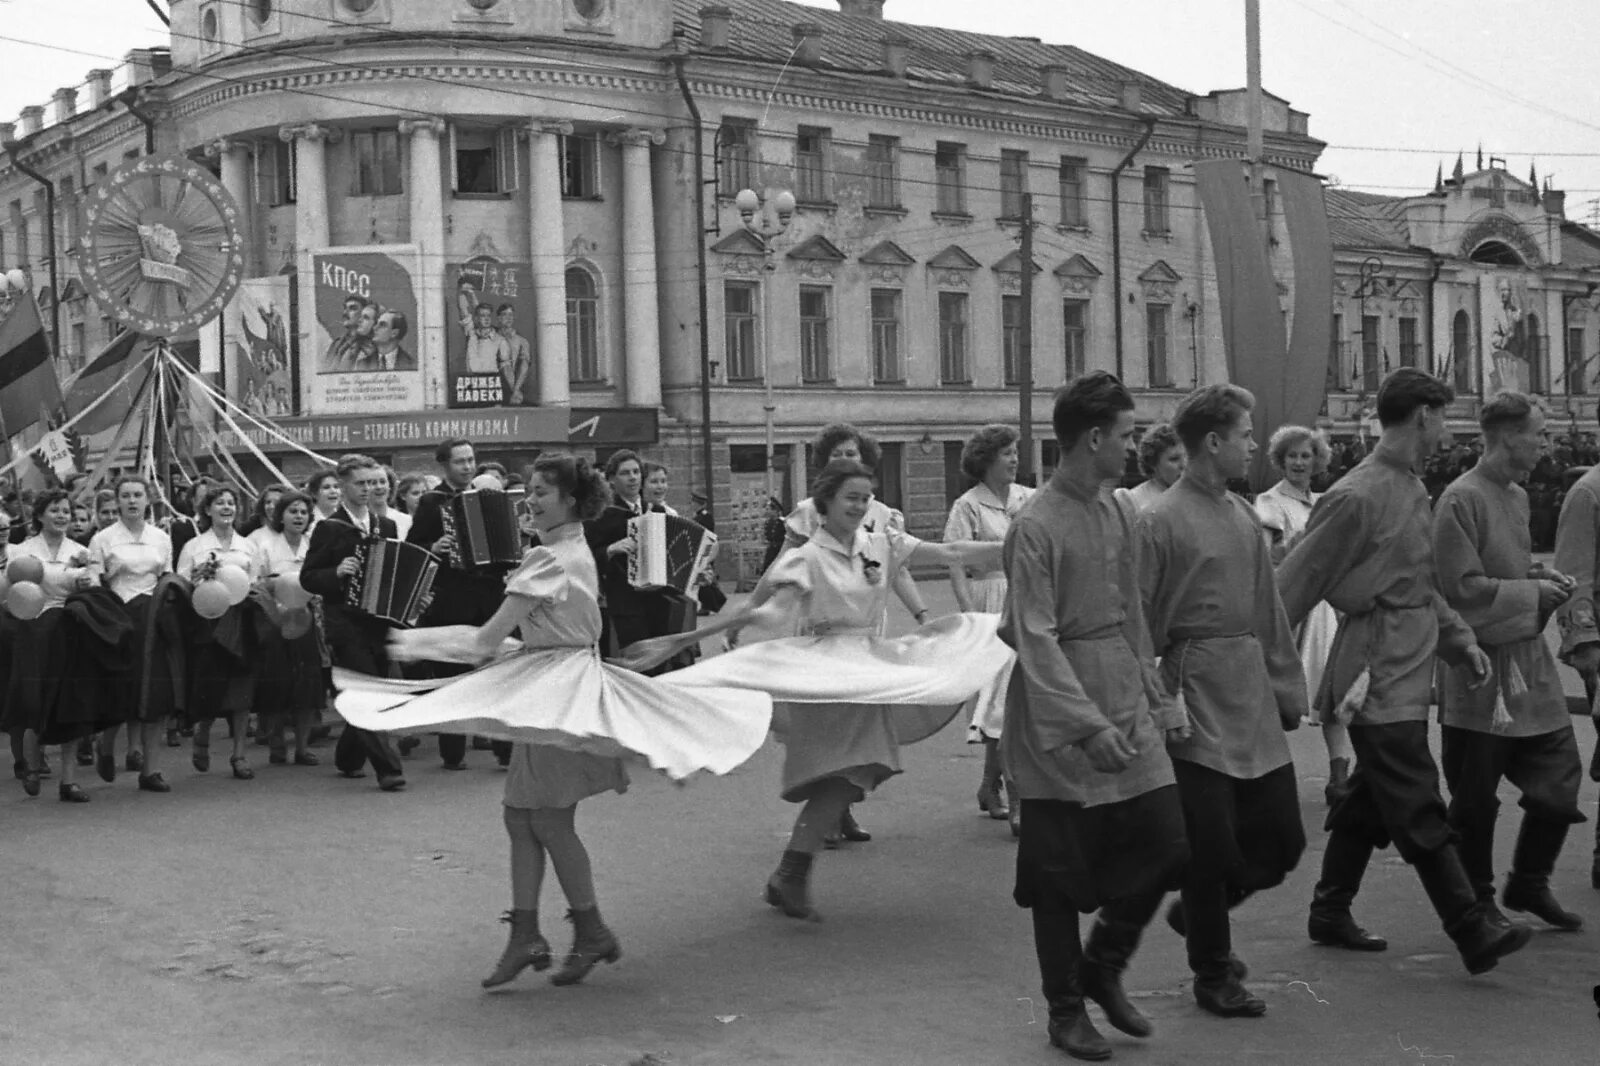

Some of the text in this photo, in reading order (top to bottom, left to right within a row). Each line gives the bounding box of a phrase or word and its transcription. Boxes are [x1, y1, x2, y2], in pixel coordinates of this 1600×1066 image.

[321, 261, 370, 298] КПСС
[456, 376, 502, 390] ДРУЖБА
[456, 388, 503, 402] НАВЕКИ
[318, 425, 349, 443] НАРОД
[364, 422, 421, 441] СТРОИТЕЛЬ
